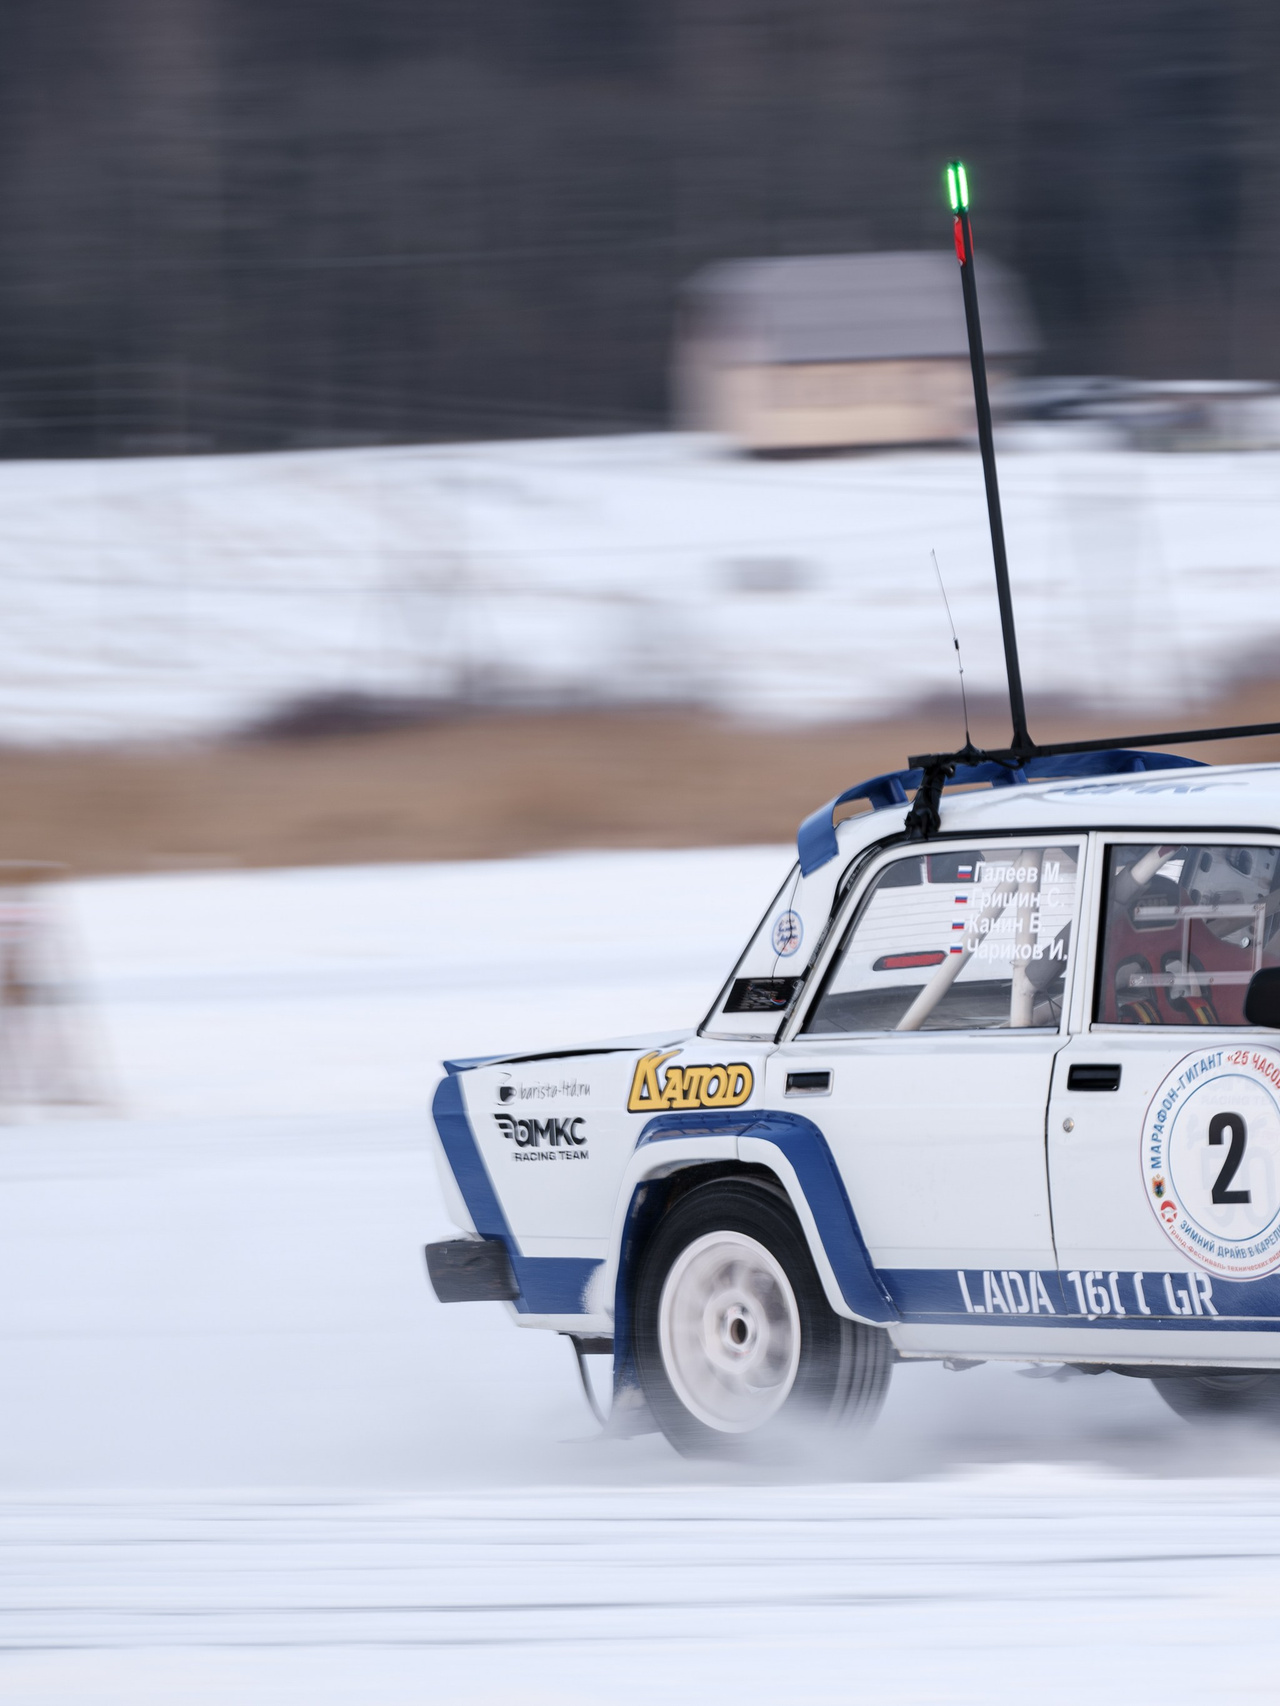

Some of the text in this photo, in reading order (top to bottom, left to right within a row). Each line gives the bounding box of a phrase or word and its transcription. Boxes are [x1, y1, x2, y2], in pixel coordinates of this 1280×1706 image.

[973, 861, 1064, 883] Галеев М.
[970, 887, 1065, 911] Гришин С.
[968, 914, 1023, 934] Канин
[966, 938, 1068, 964] Чариков И.
[518, 1079, 591, 1100] barista-ltd.ru
[627, 1048, 755, 1113] KATOD
[1150, 1051, 1224, 1169] МАРАФОН-ГИГАНТ
[513, 1150, 589, 1162] RACING TEAM
[1208, 1112, 1253, 1205] 2
[1180, 1219, 1216, 1253] ЗИМНИЙ
[1217, 1245, 1247, 1259] ДРАЙВ
[1249, 1248, 1255, 1257] В
[957, 1270, 1056, 1315] LADA
[1162, 1272, 1219, 1316] GR
